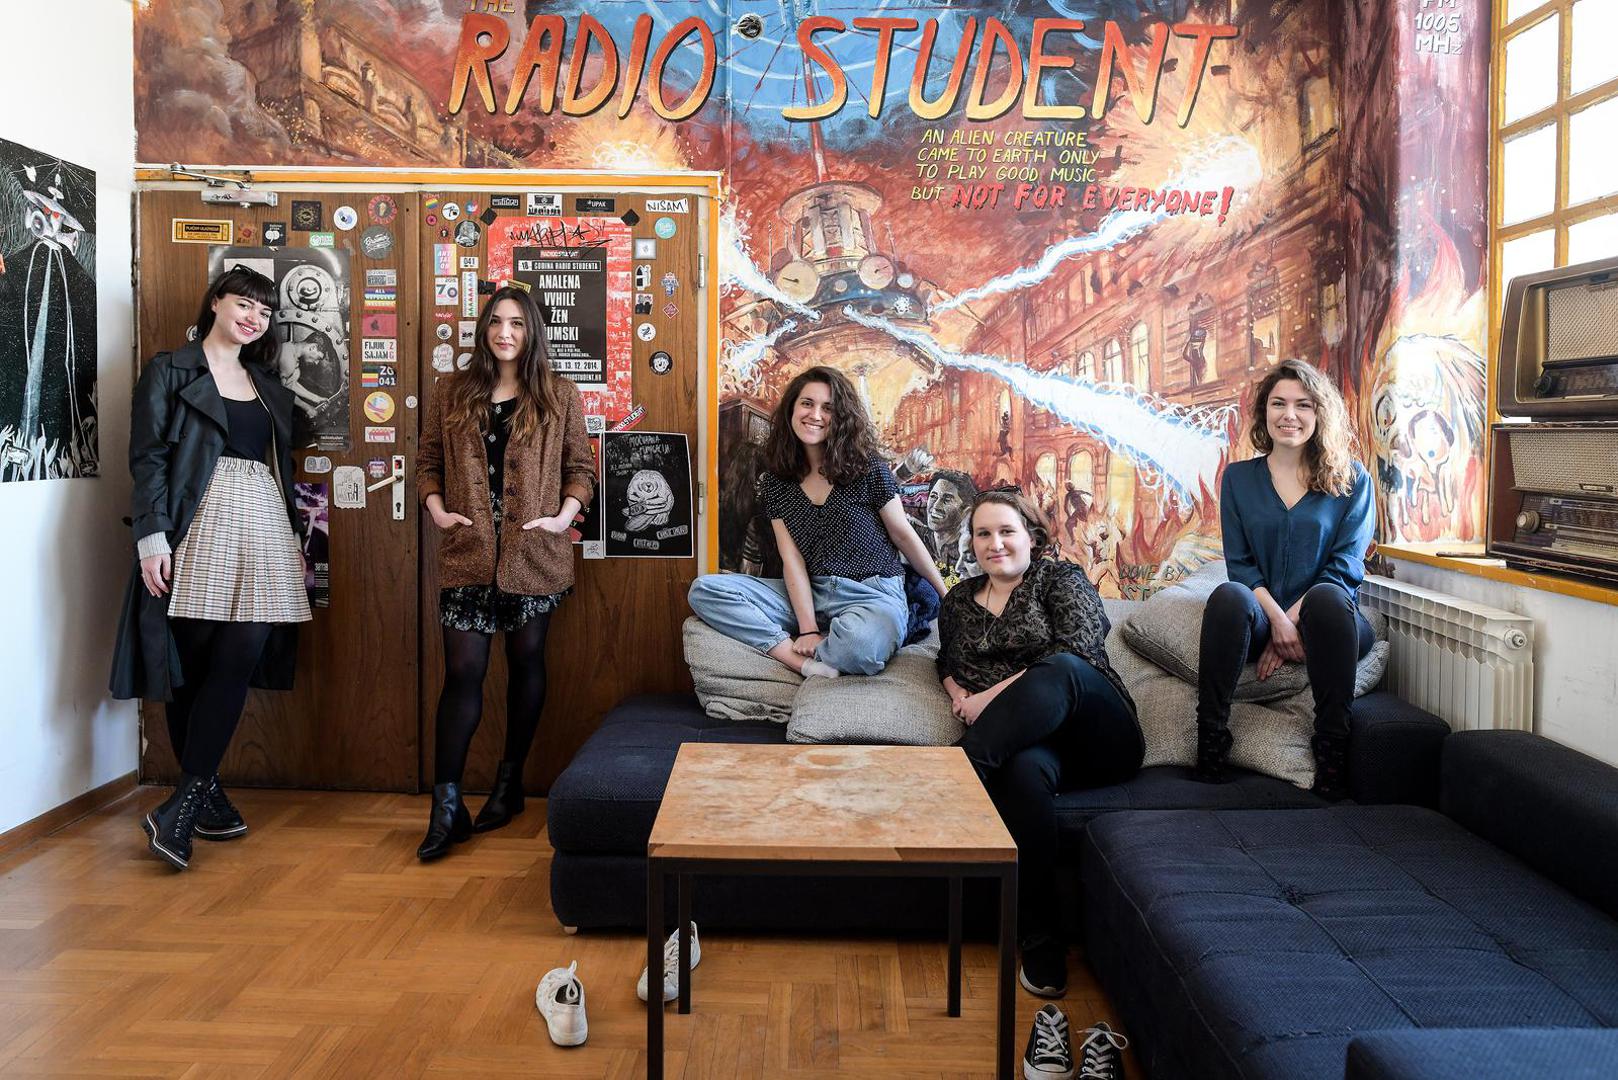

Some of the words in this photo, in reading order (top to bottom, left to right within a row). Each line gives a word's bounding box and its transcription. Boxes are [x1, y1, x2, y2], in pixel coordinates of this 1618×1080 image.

[448, 13, 717, 121] RADIO
[781, 15, 1239, 128] STUDENT
[920, 129, 944, 144] AN
[949, 129, 995, 145] ALIEN
[1004, 131, 1087, 147] CREATURE
[917, 147, 958, 162] CAME
[966, 148, 987, 163] TO
[992, 149, 1047, 163] EARTH
[1059, 150, 1100, 165] ONLY
[915, 163, 938, 179] TO
[947, 165, 987, 179] PLAY
[995, 167, 1038, 182] GOOD
[1050, 167, 1096, 182] MUSIC
[911, 186, 944, 200] BUT
[951, 183, 1005, 209] NOT
[1013, 183, 1067, 210] FOR
[1082, 183, 1235, 227] EVERYONE!
[555, 262, 571, 270] RADIO
[572, 262, 598, 270] STUDENTA
[539, 274, 581, 289] ANALENA
[550, 306, 569, 324] ŽEN
[544, 323, 579, 341] UMSKI
[378, 377, 396, 386] 041
[1164, 564, 1187, 581] BY
